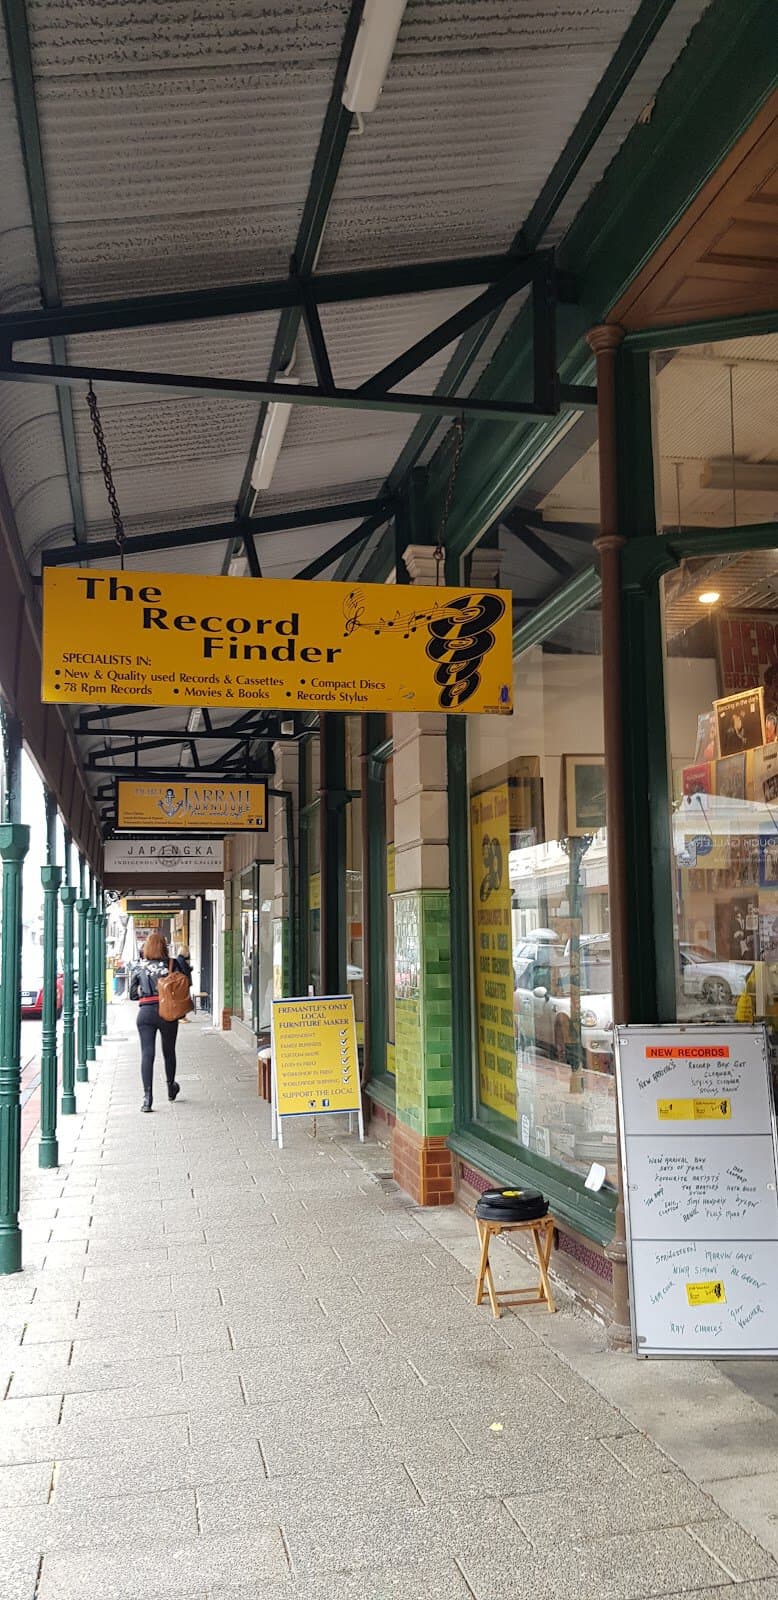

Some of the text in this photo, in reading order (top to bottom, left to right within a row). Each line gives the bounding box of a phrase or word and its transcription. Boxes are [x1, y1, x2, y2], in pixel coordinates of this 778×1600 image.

[77, 577, 162, 603] The
[142, 607, 300, 637] Record
[203, 636, 342, 664] Finder
[62, 652, 152, 667] SPECIALISTS IN:
[64, 668, 285, 687] New & Quality used Records & Cassettes
[310, 677, 387, 691] Compact Discs
[63, 682, 153, 696] 78 Rpm Records
[184, 687, 271, 700] Movies & Books
[296, 690, 369, 705] Records Stylus
[183, 787, 250, 804] JARRAH
[128, 845, 214, 855] JAPINGKA
[279, 1020, 320, 1028] FURNITURE
[651, 1048, 725, 1057] NEW RECORDS
[282, 1091, 313, 1099] SUPPORT
[316, 1089, 329, 1097] THE
